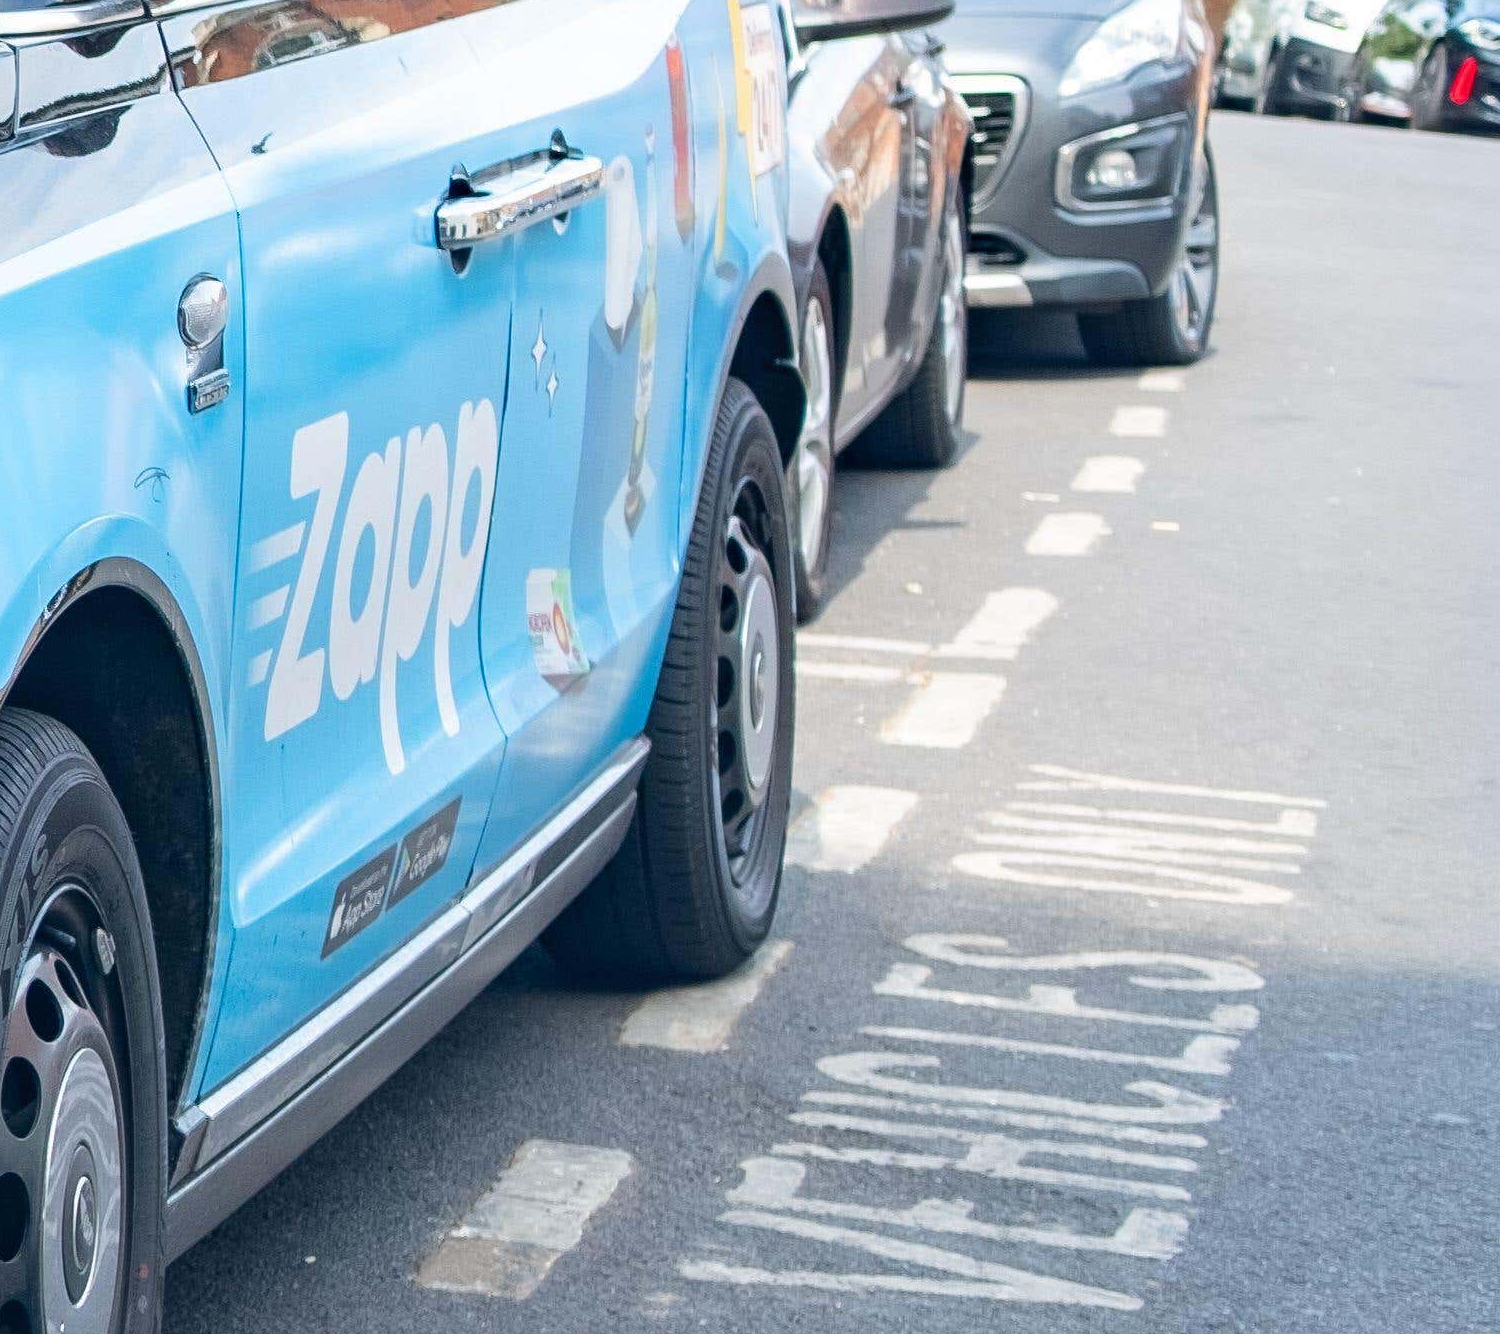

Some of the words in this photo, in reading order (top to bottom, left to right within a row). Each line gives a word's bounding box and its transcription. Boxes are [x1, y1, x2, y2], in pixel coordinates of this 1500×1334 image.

[264, 398, 497, 774] Zapp
[951, 762, 1329, 907] ONLY
[680, 930, 1265, 1312] VEHICLES
